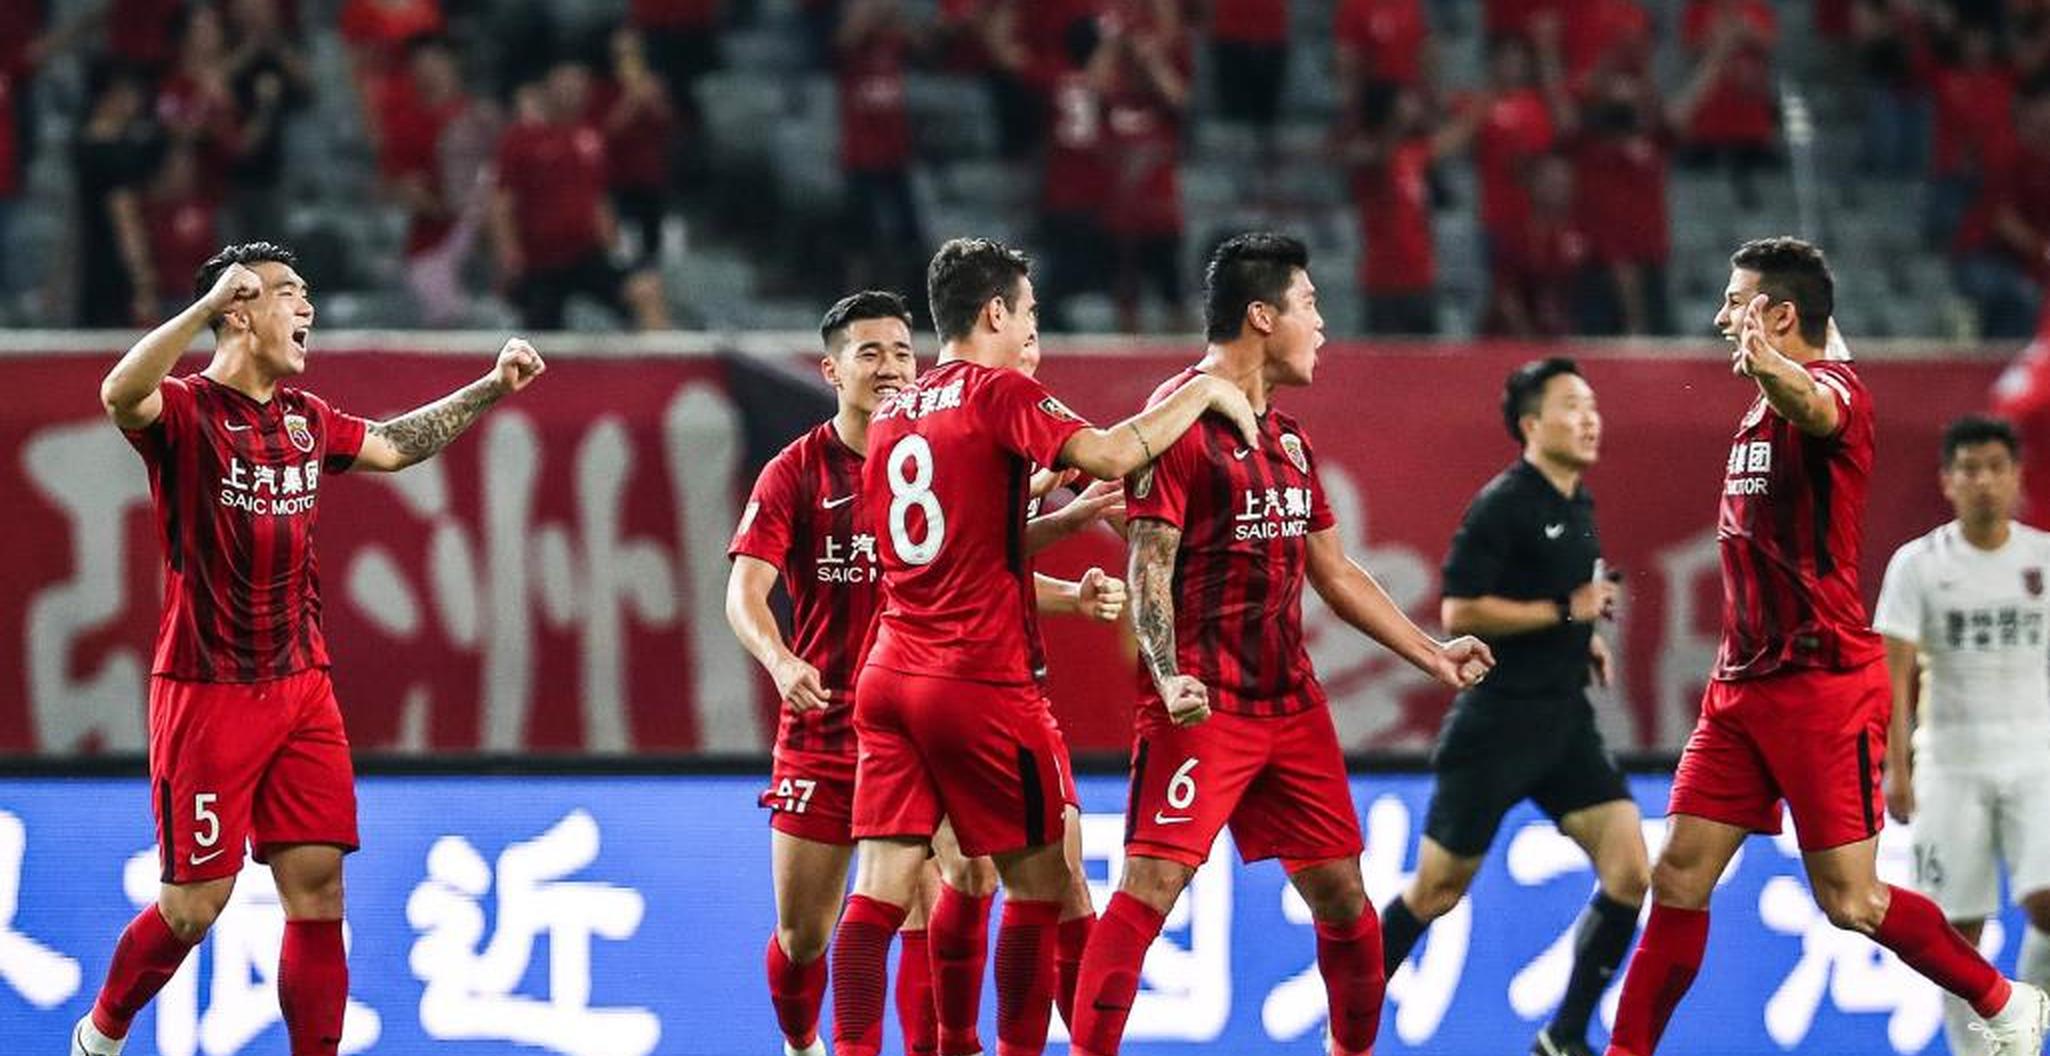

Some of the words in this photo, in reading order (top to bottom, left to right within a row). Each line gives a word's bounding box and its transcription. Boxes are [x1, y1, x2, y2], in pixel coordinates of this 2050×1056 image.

[220, 489, 267, 515] SAIC
[886, 433, 945, 566] 8
[1235, 521, 1279, 541] SAIC
[816, 533, 877, 563] 上汽
[817, 566, 864, 583] SAIC
[1167, 757, 1200, 810] 6
[194, 793, 219, 847] 5
